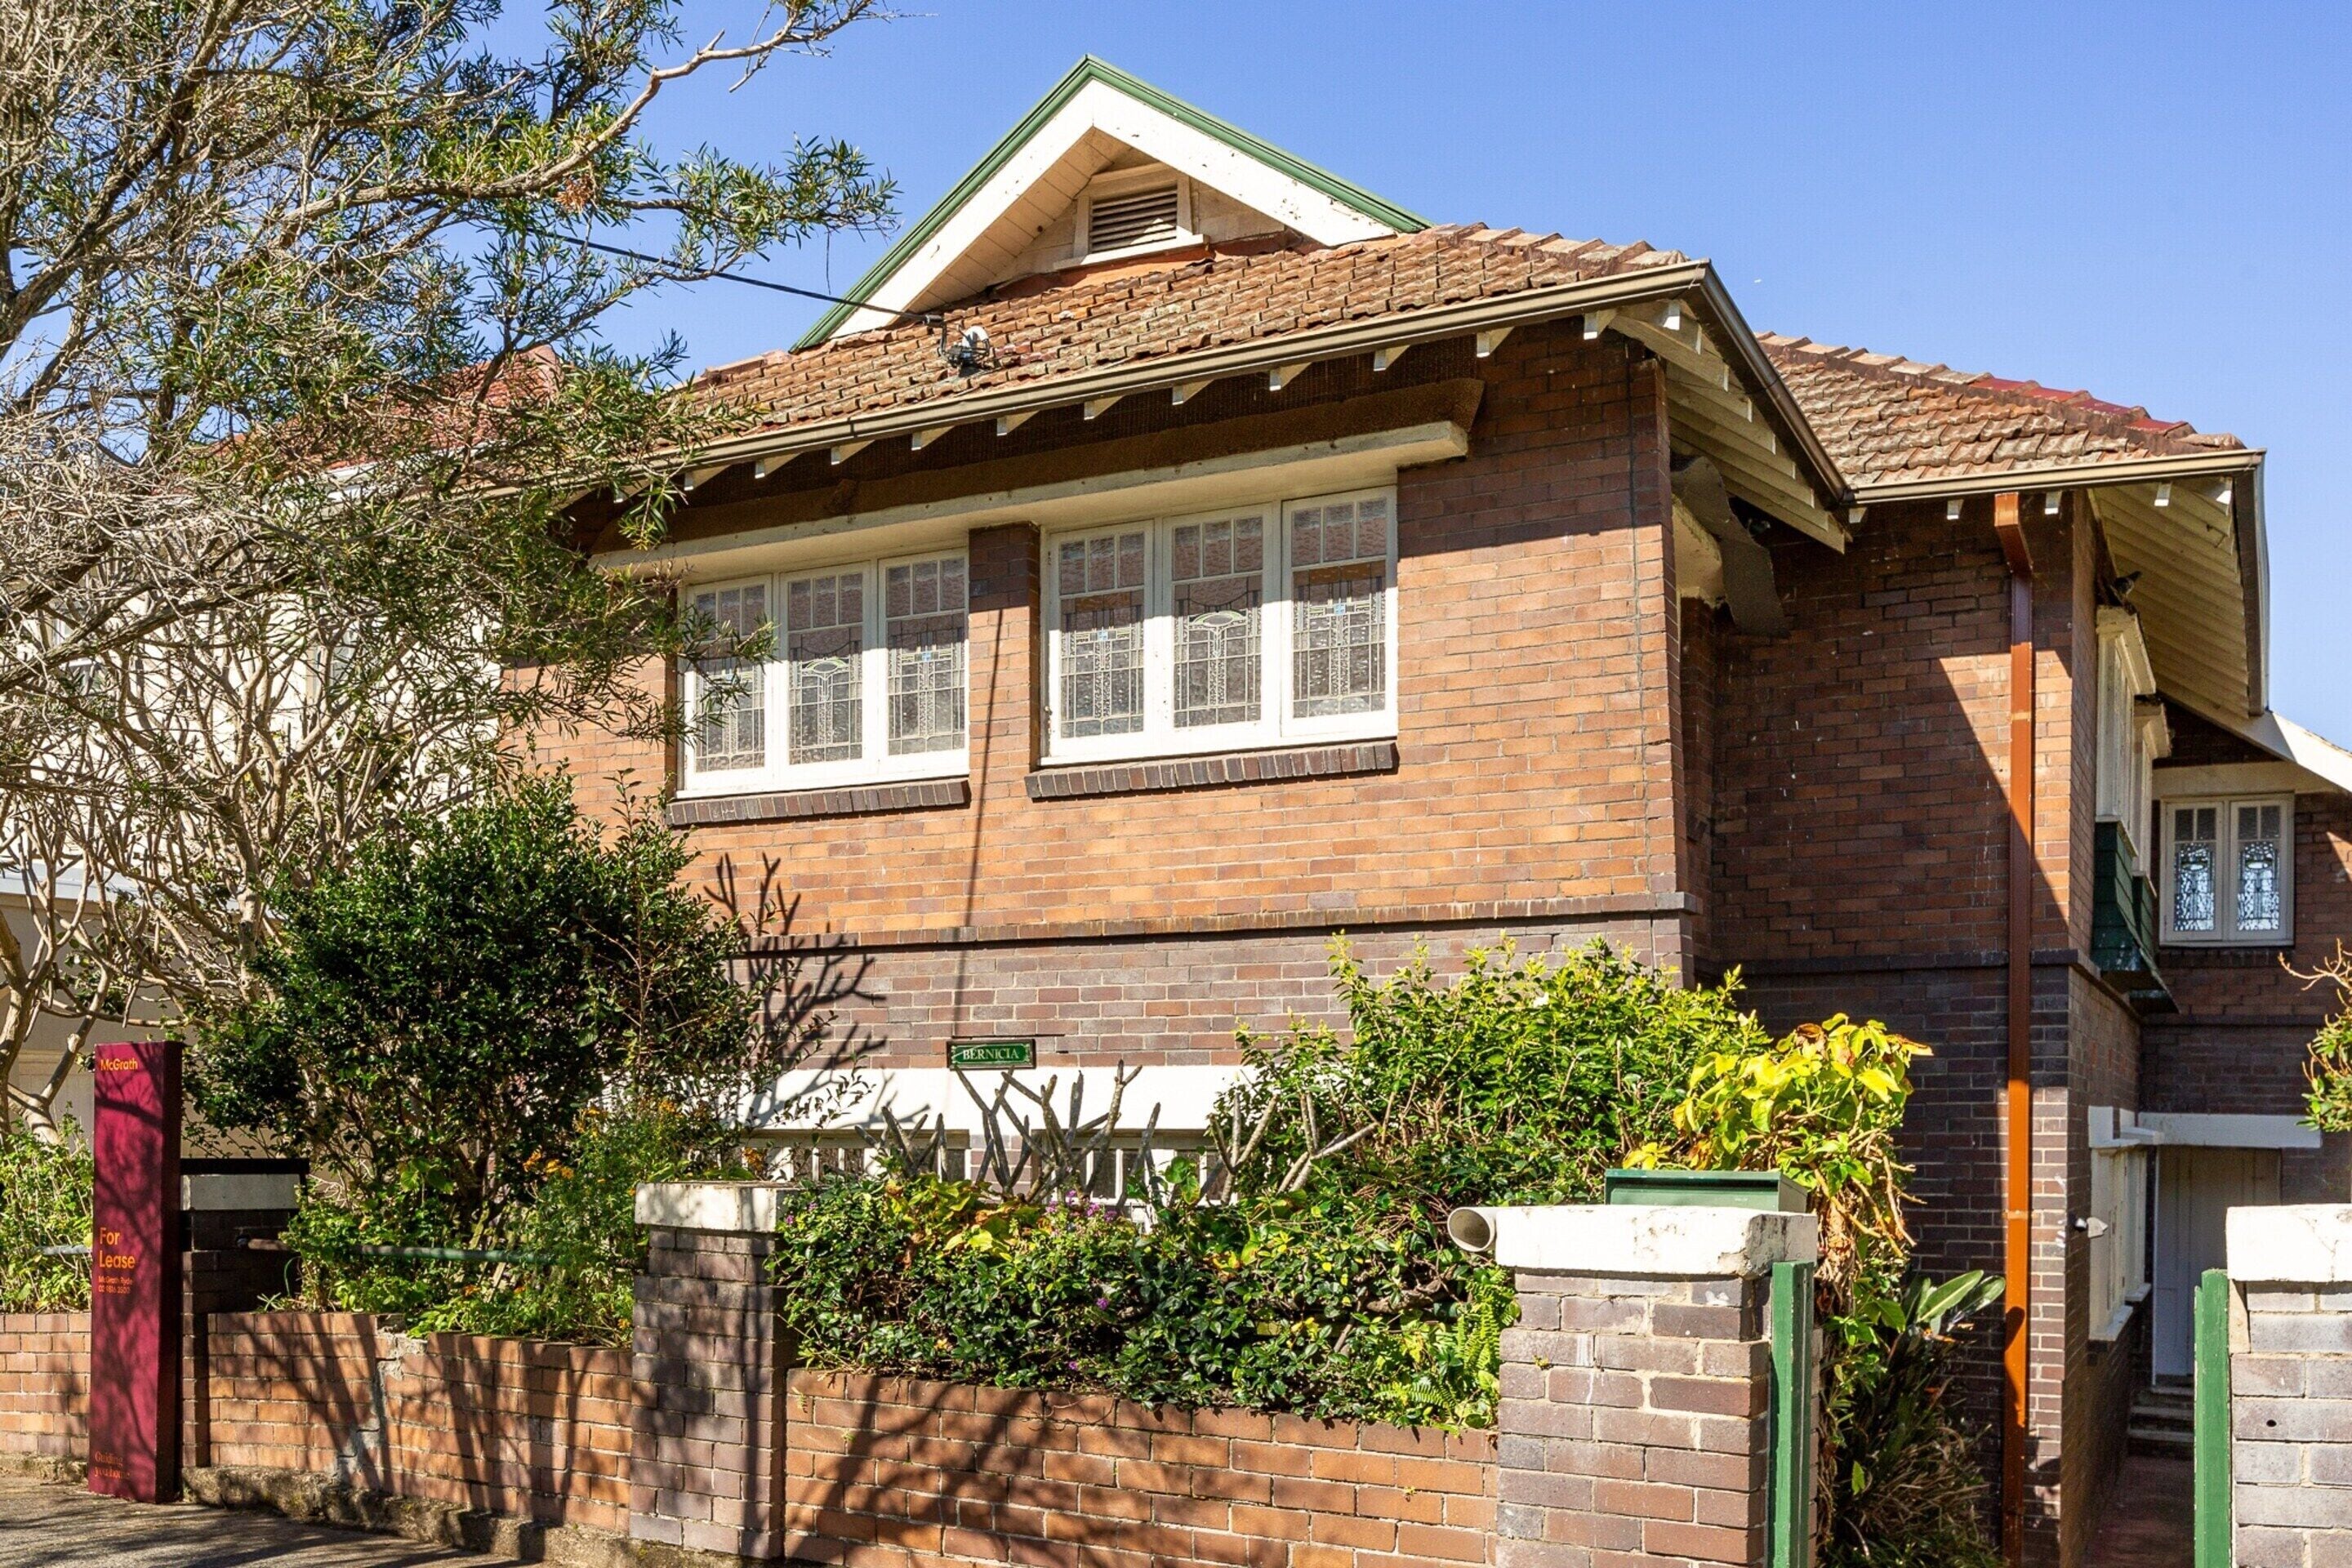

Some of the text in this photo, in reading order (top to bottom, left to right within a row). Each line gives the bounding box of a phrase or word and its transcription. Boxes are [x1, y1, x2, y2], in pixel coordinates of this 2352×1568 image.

[963, 1048, 1019, 1060] BERNICIA
[100, 1057, 139, 1071] McGrath
[100, 1227, 120, 1245] For
[99, 1250, 136, 1268] Lease
[95, 1450, 123, 1468] Guiding
